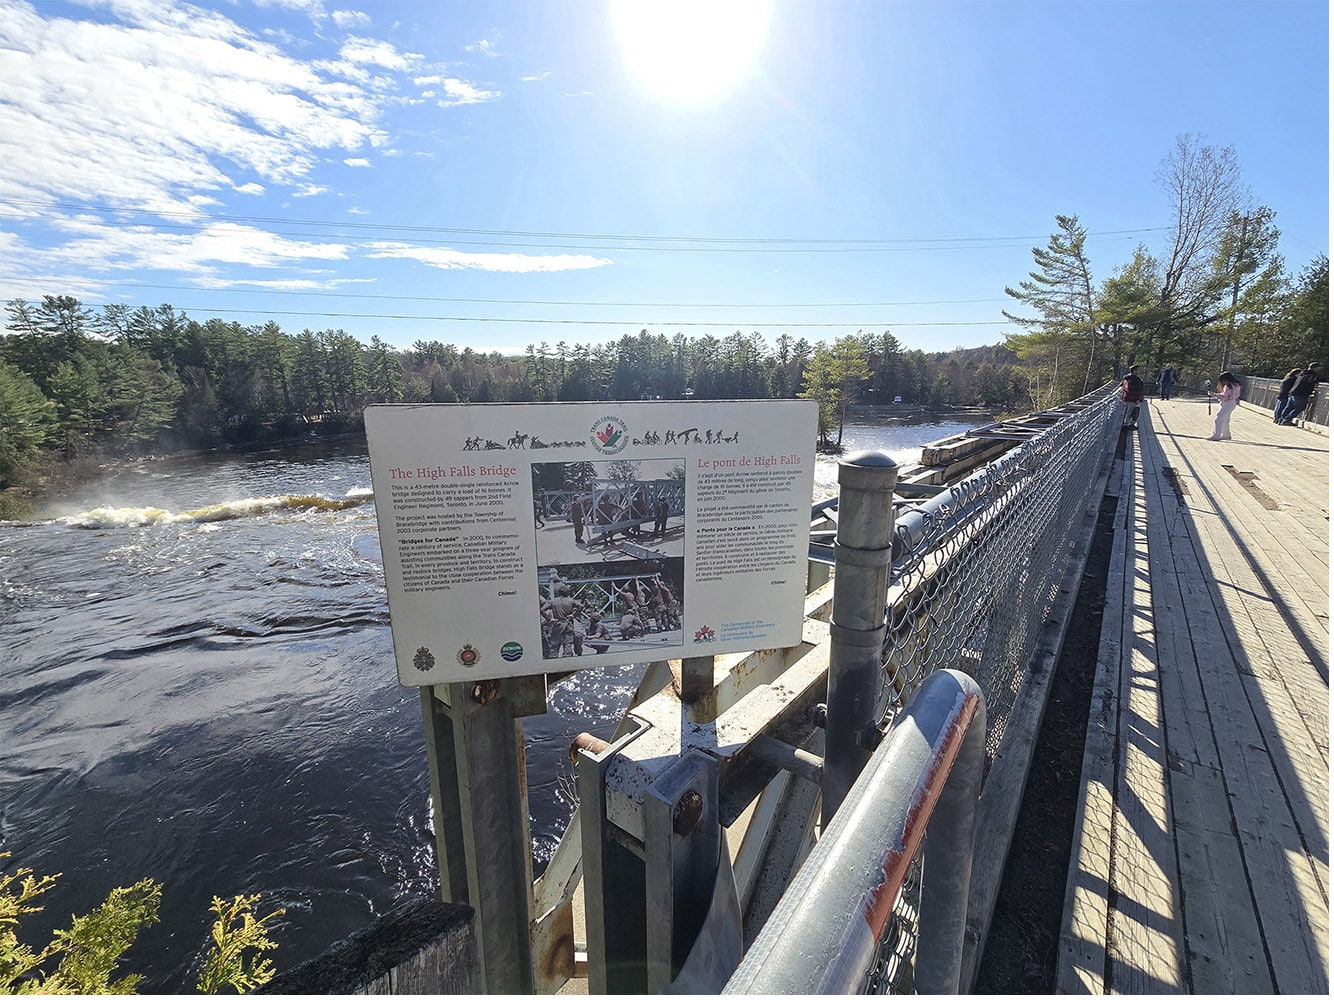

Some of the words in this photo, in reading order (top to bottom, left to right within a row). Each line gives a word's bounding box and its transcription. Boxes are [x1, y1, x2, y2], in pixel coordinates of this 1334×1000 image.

[698, 459, 709, 468] Le
[712, 460, 736, 470] pont
[739, 456, 751, 466] de
[754, 456, 776, 468] High
[781, 455, 800, 464] Falls
[389, 468, 412, 479] The
[417, 466, 446, 480] High
[450, 466, 476, 476] Falls
[479, 465, 516, 478] Bridge
